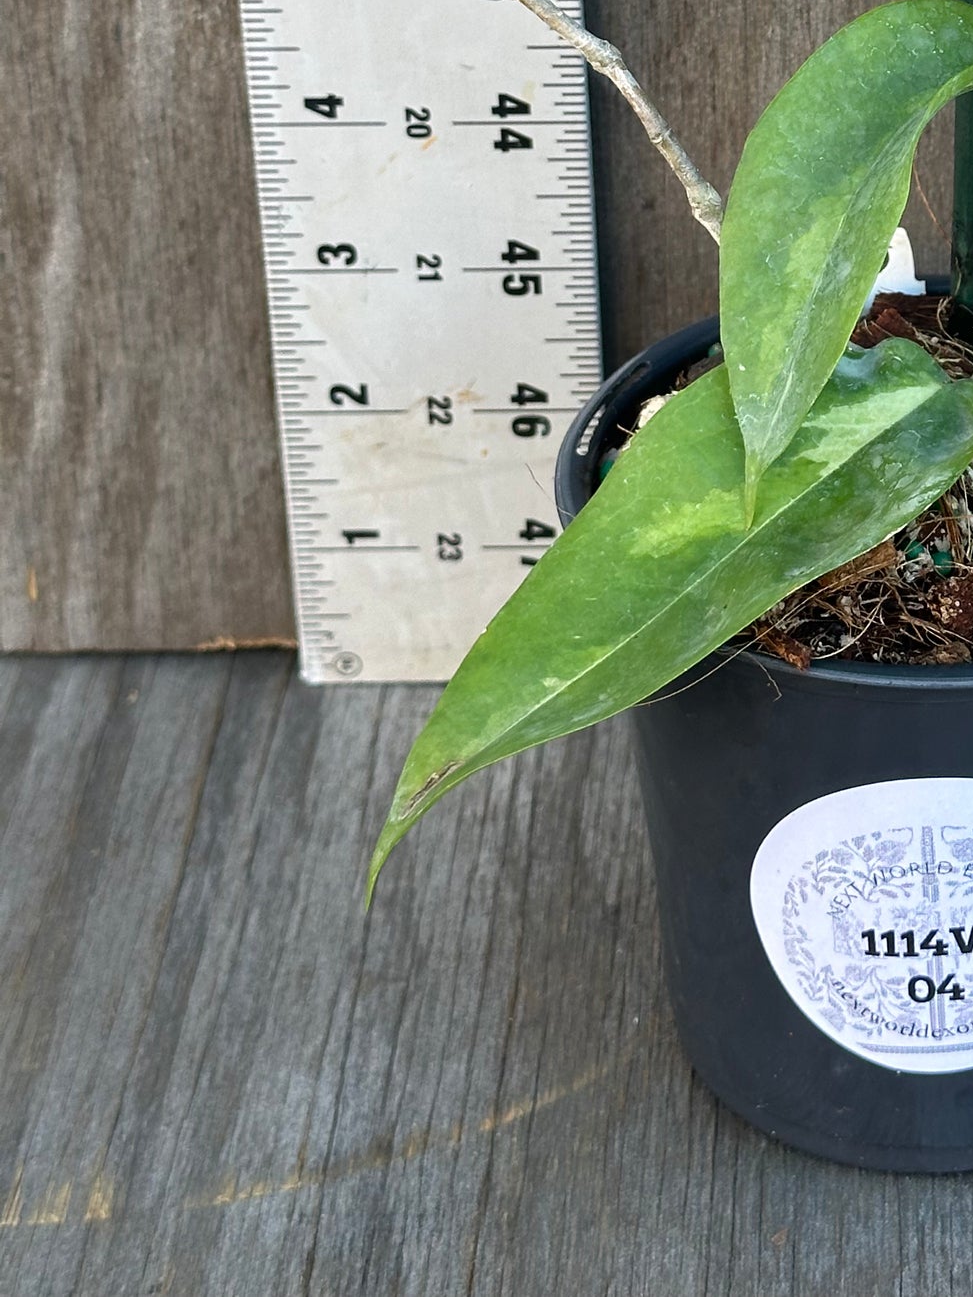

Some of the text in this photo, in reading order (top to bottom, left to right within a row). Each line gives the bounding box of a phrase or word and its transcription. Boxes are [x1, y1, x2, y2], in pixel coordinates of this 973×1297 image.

[303, 93, 345, 120] 4
[404, 106, 432, 140] 20
[491, 92, 534, 154] 44
[316, 242, 358, 267] 3
[416, 254, 443, 283] 21
[500, 239, 542, 298] 45
[329, 383, 370, 407] 2
[427, 395, 453, 426] 22
[510, 382, 552, 439] 46
[341, 528, 380, 546] 1
[436, 532, 463, 562] 23
[826, 880, 864, 921] NEXT
[865, 860, 954, 888] WORLD
[907, 973, 966, 1004] 04
